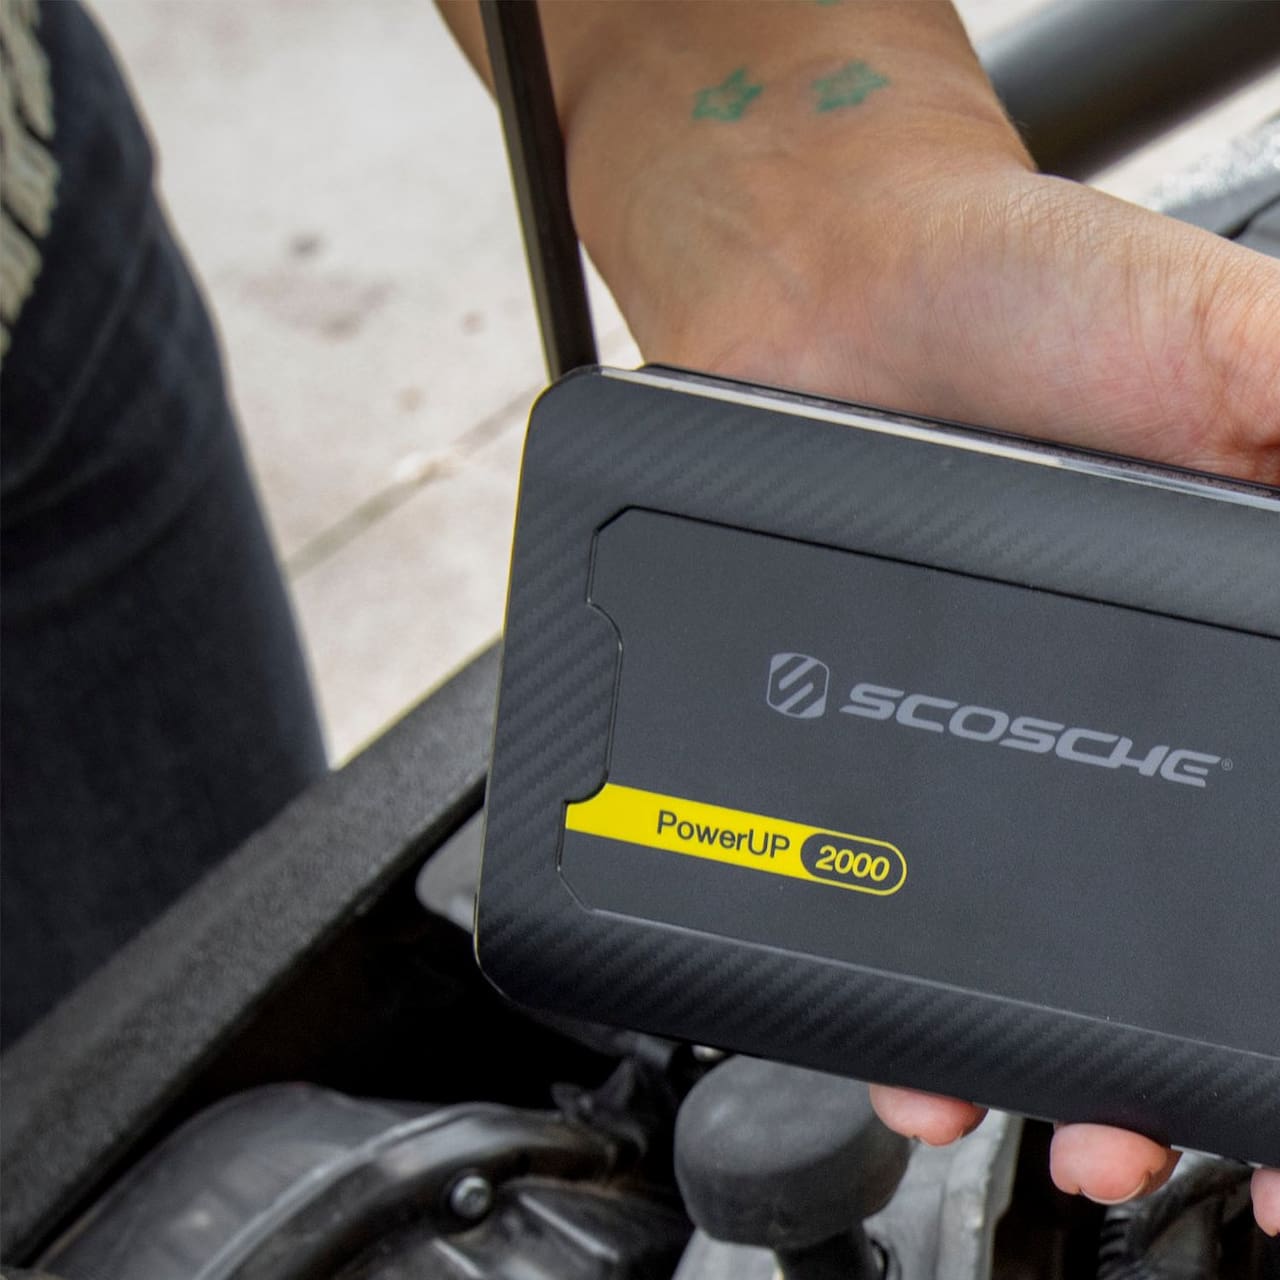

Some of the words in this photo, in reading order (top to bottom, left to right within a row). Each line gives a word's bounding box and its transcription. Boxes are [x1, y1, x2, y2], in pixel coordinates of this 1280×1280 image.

[840, 682, 1221, 788] SCOSCHE
[656, 808, 791, 860] PowerUP
[814, 843, 891, 883] 2000
